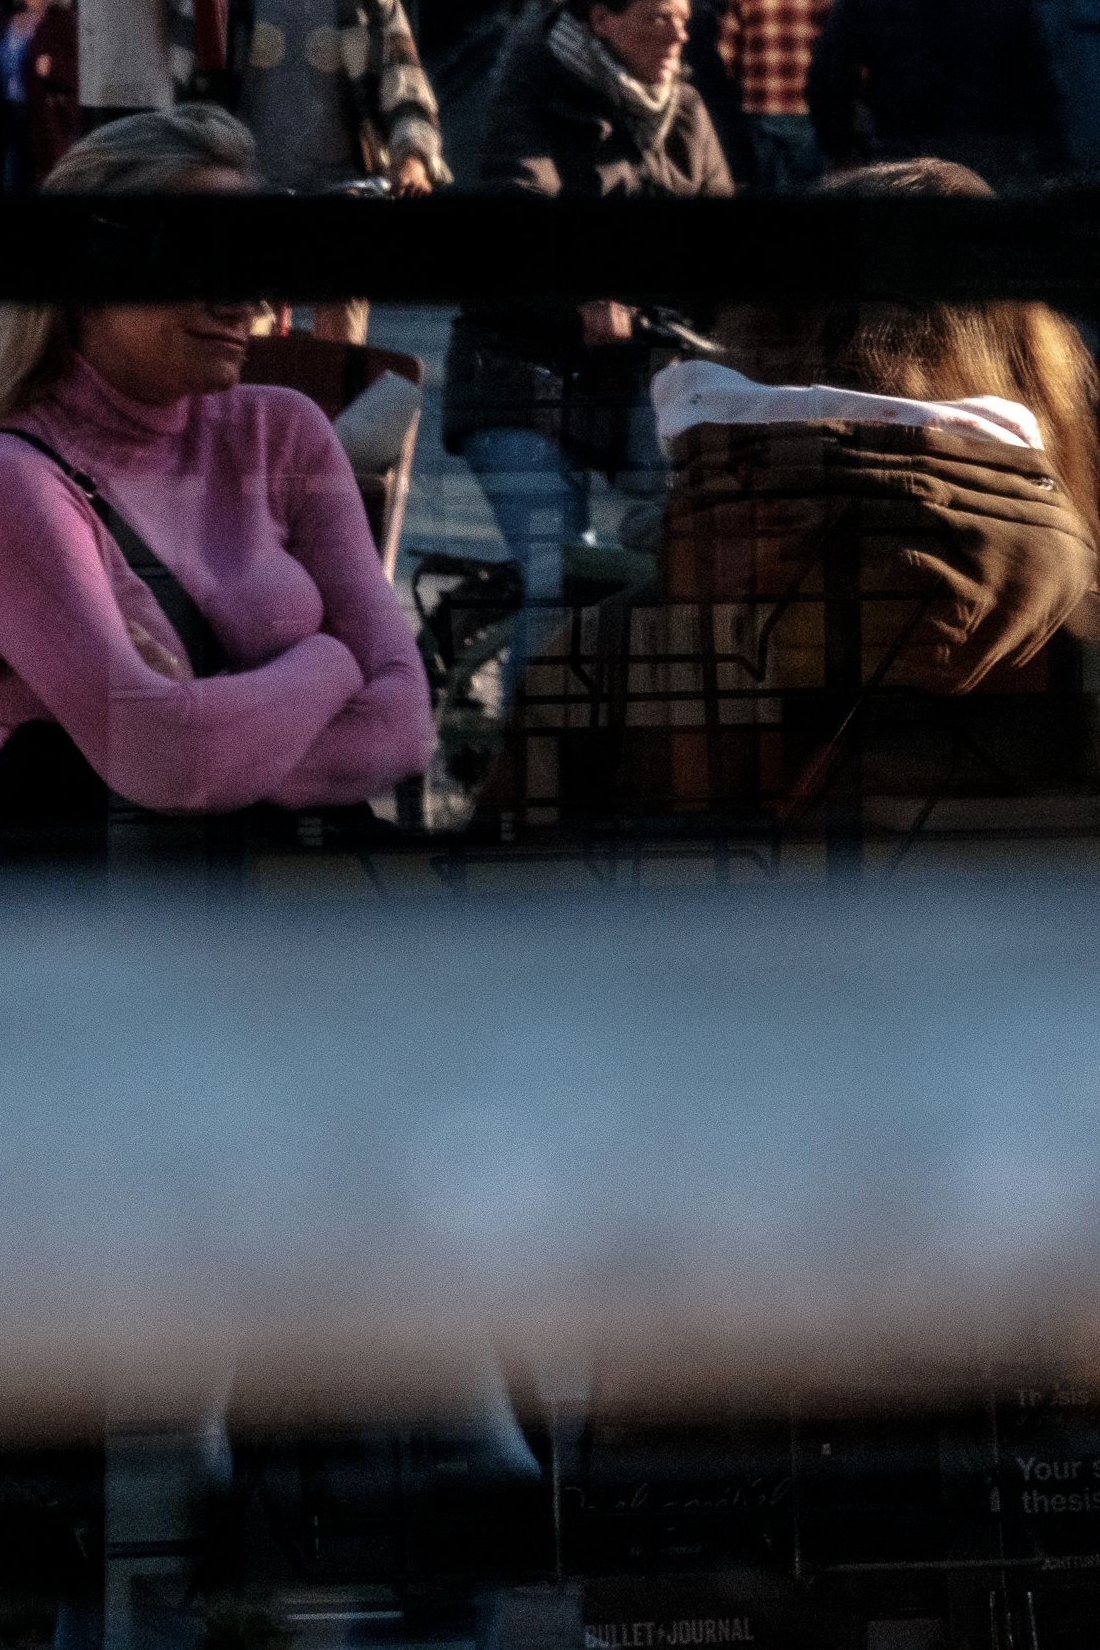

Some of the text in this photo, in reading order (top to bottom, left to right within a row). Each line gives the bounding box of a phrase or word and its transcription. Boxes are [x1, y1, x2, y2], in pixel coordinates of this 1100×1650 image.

[1015, 1456, 1082, 1482] Your
[584, 1615, 754, 1649] BULLET JOURNAL
